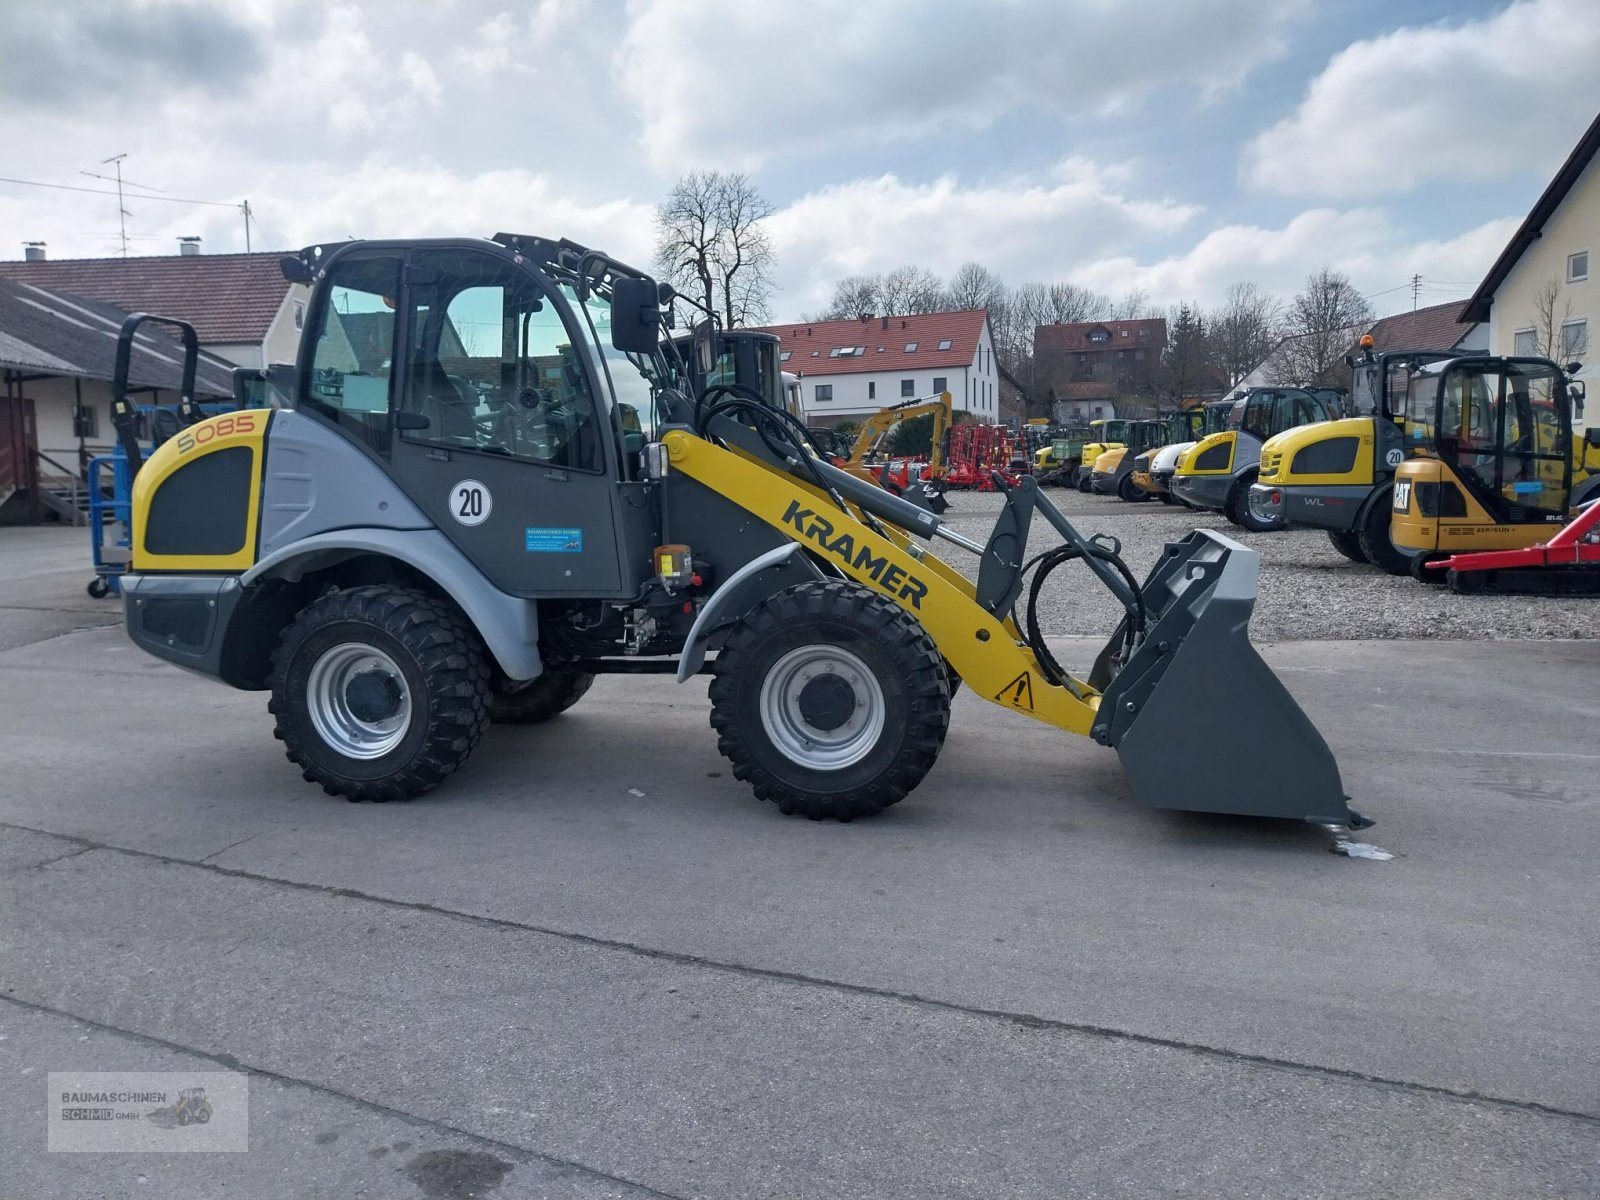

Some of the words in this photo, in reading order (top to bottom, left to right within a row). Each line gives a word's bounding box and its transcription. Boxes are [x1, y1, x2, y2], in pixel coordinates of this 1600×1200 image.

[177, 415, 256, 455] 5085
[1390, 452, 1401, 464] 20
[459, 488, 482, 517] 20
[1394, 482, 1411, 509] CAT
[781, 499, 928, 610] KRAMER
